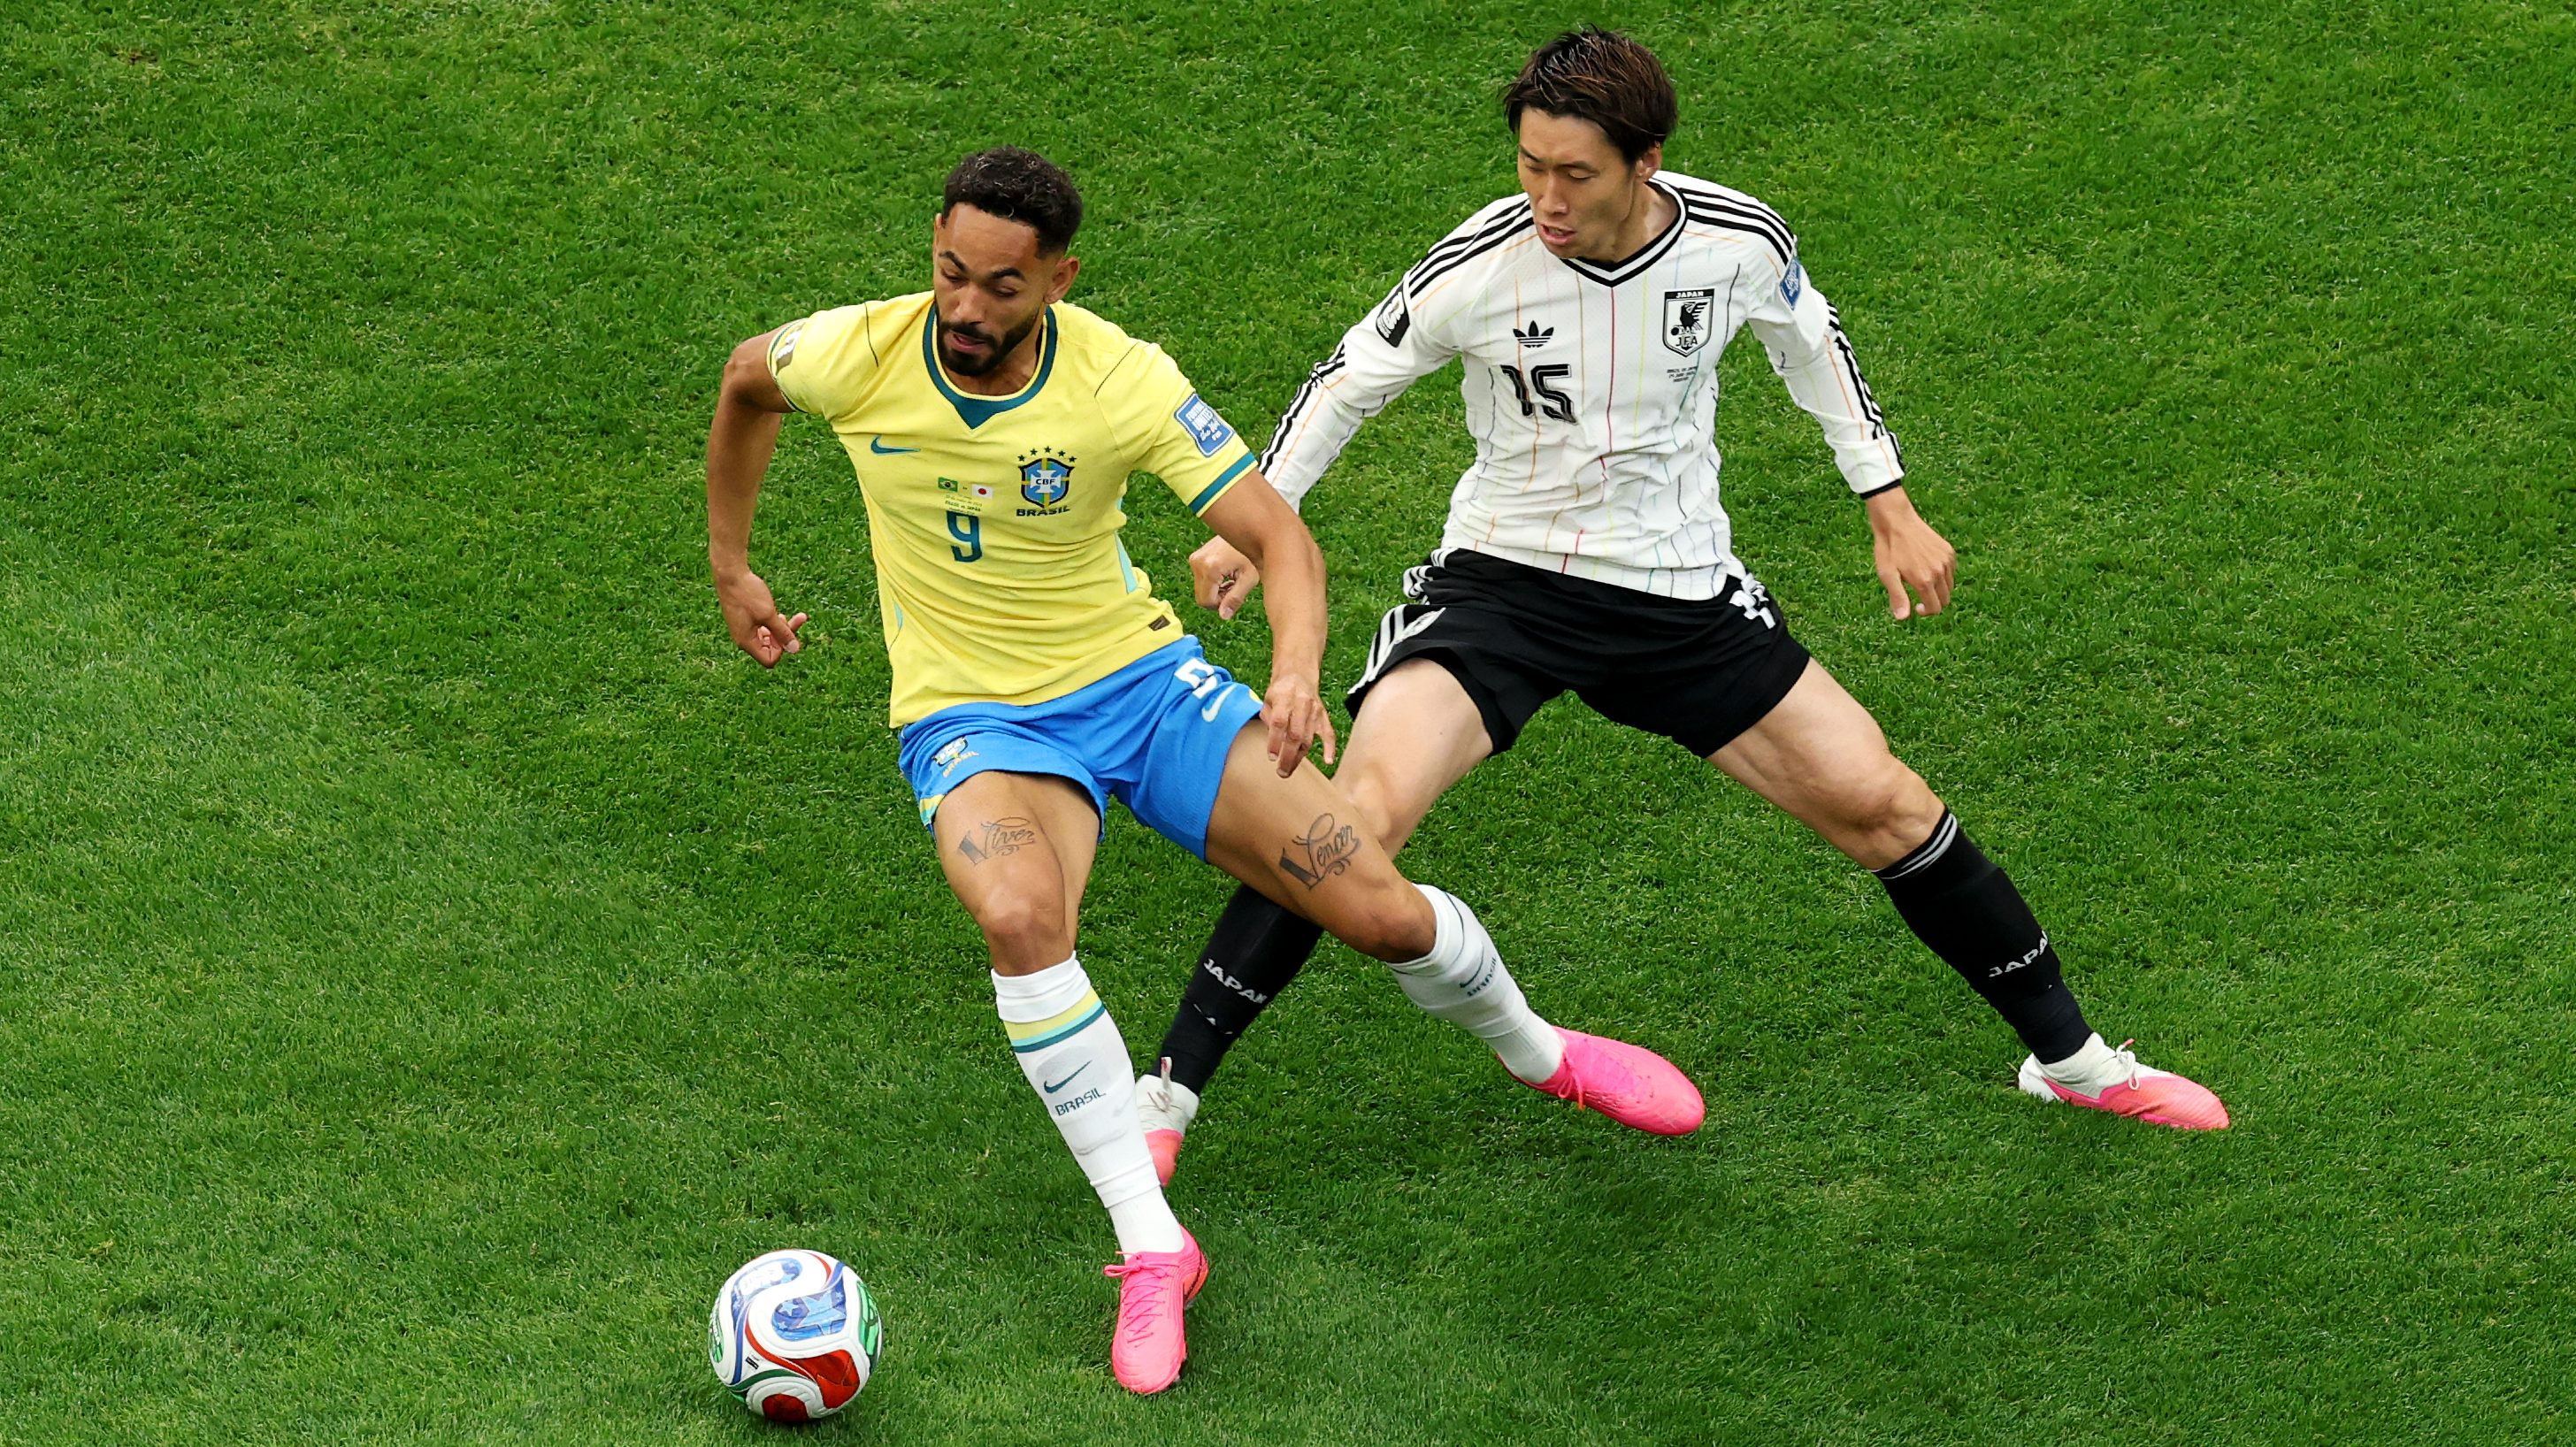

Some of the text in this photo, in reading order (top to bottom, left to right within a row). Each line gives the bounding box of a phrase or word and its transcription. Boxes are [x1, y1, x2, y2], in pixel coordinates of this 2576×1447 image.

[1675, 335, 1698, 347] JFA
[1500, 364, 1577, 425] 15
[1016, 505, 1070, 517] BRASIL
[947, 510, 983, 563] 9
[1174, 658, 1217, 700] 9
[1989, 930, 2048, 977] JAPA
[1054, 1088, 1107, 1116] BRASIL
